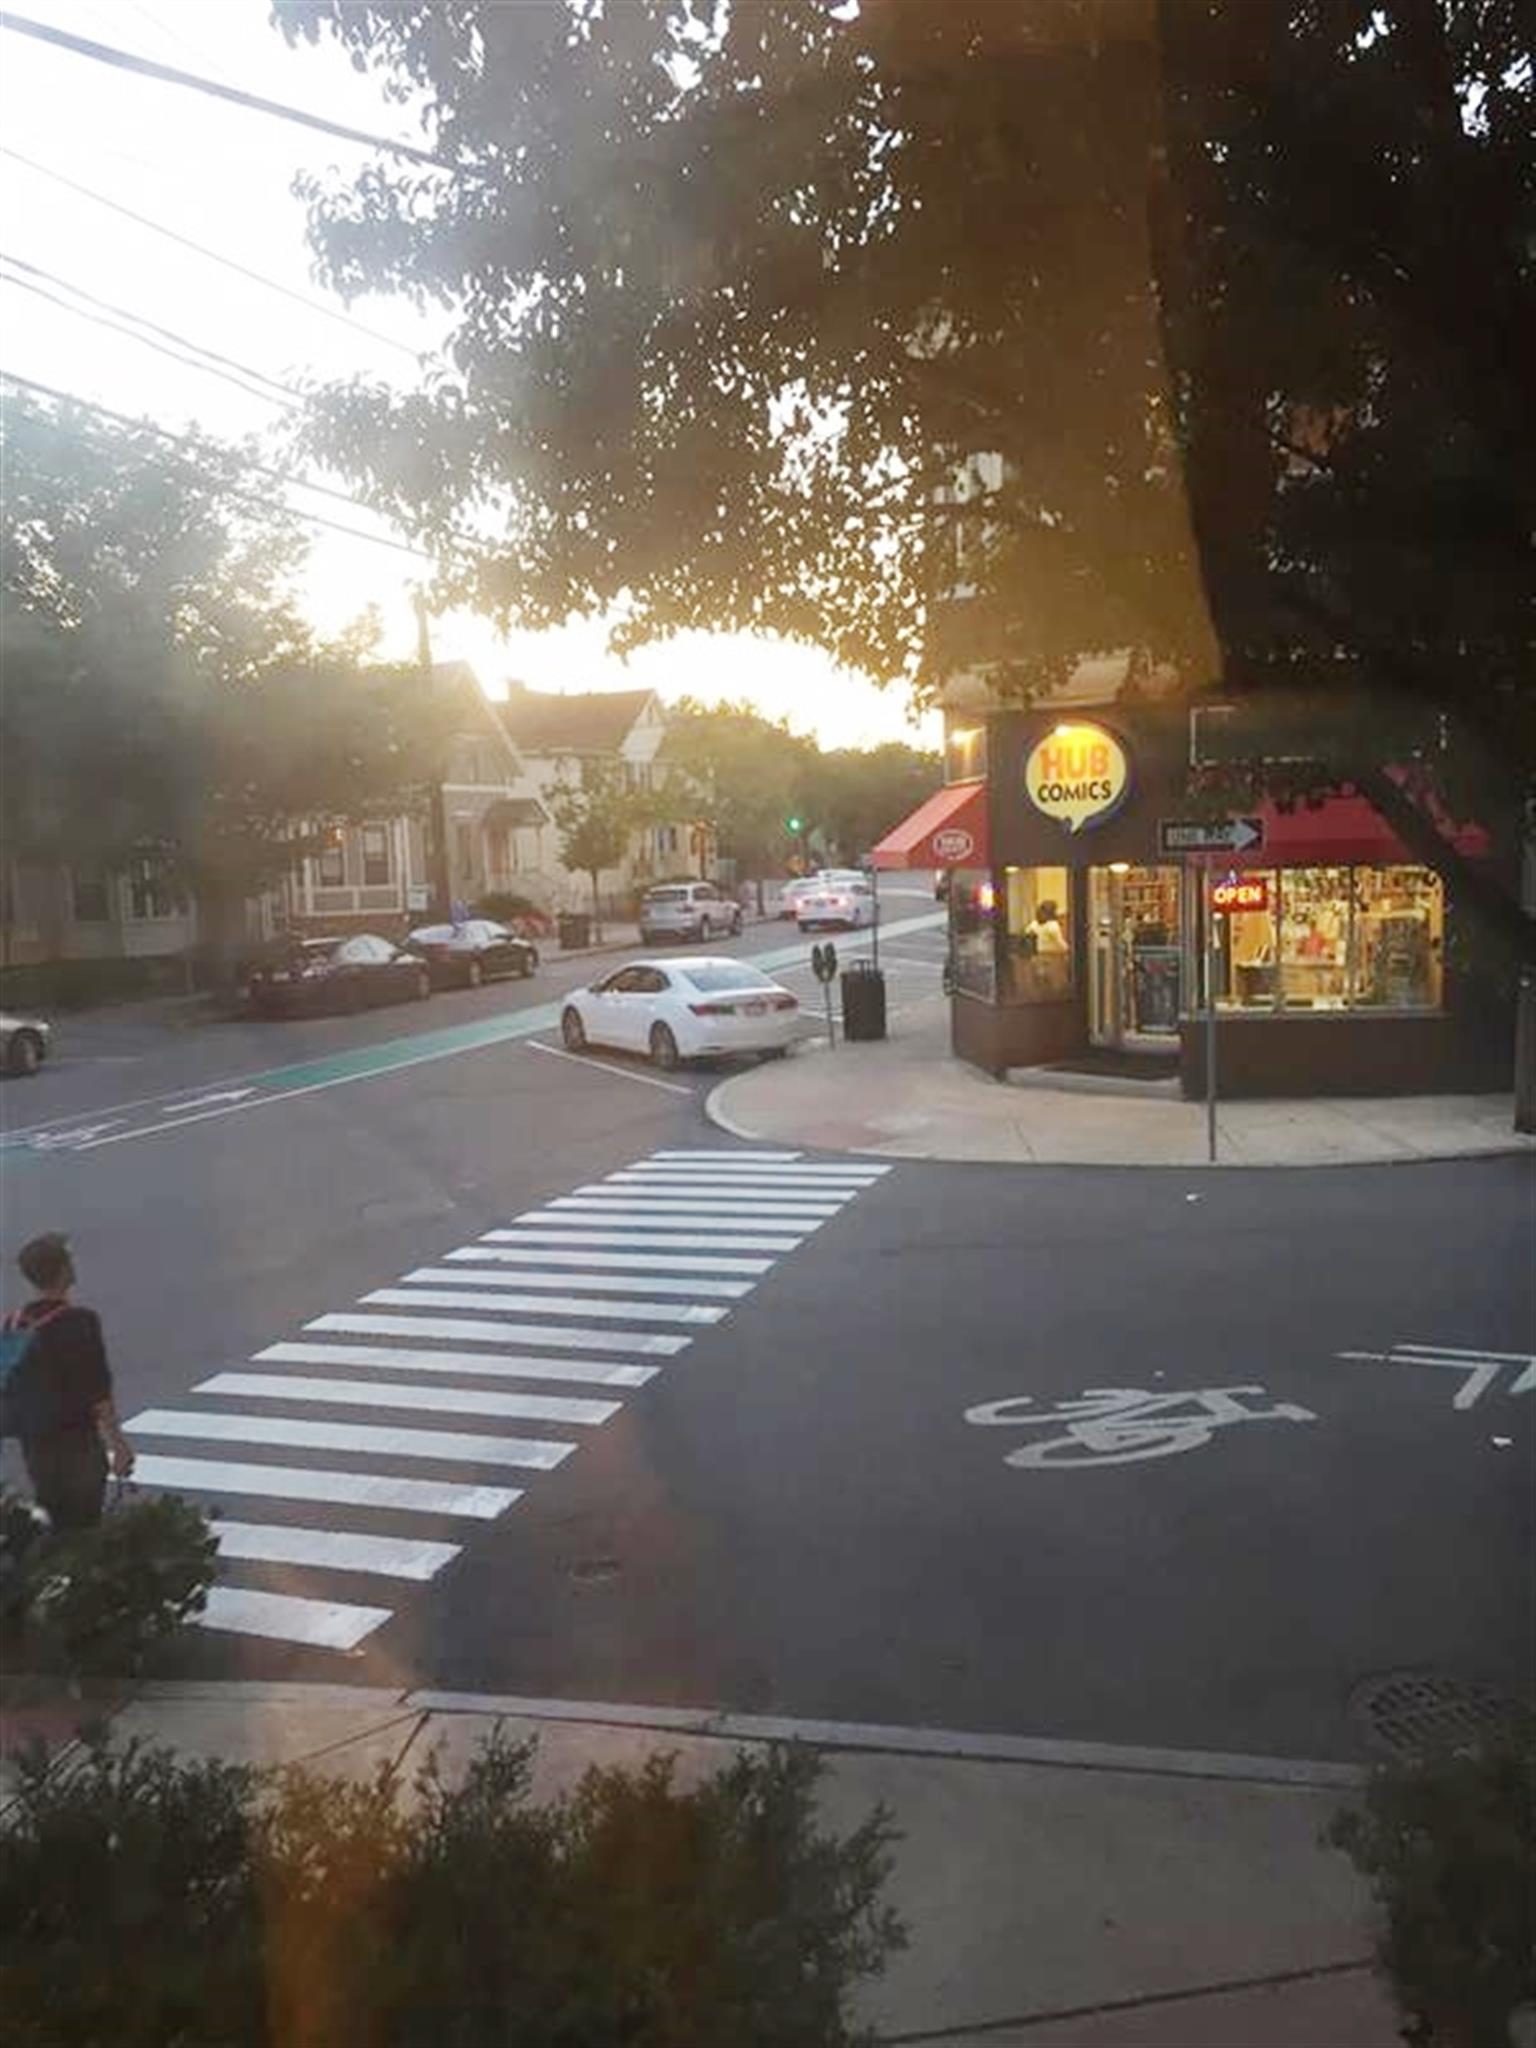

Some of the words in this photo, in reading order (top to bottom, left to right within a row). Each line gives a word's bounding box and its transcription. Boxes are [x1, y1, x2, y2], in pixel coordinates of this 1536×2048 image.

[1040, 744, 1109, 780] HUB
[1038, 780, 1112, 803] COMICS
[1214, 887, 1262, 905] OPEN
